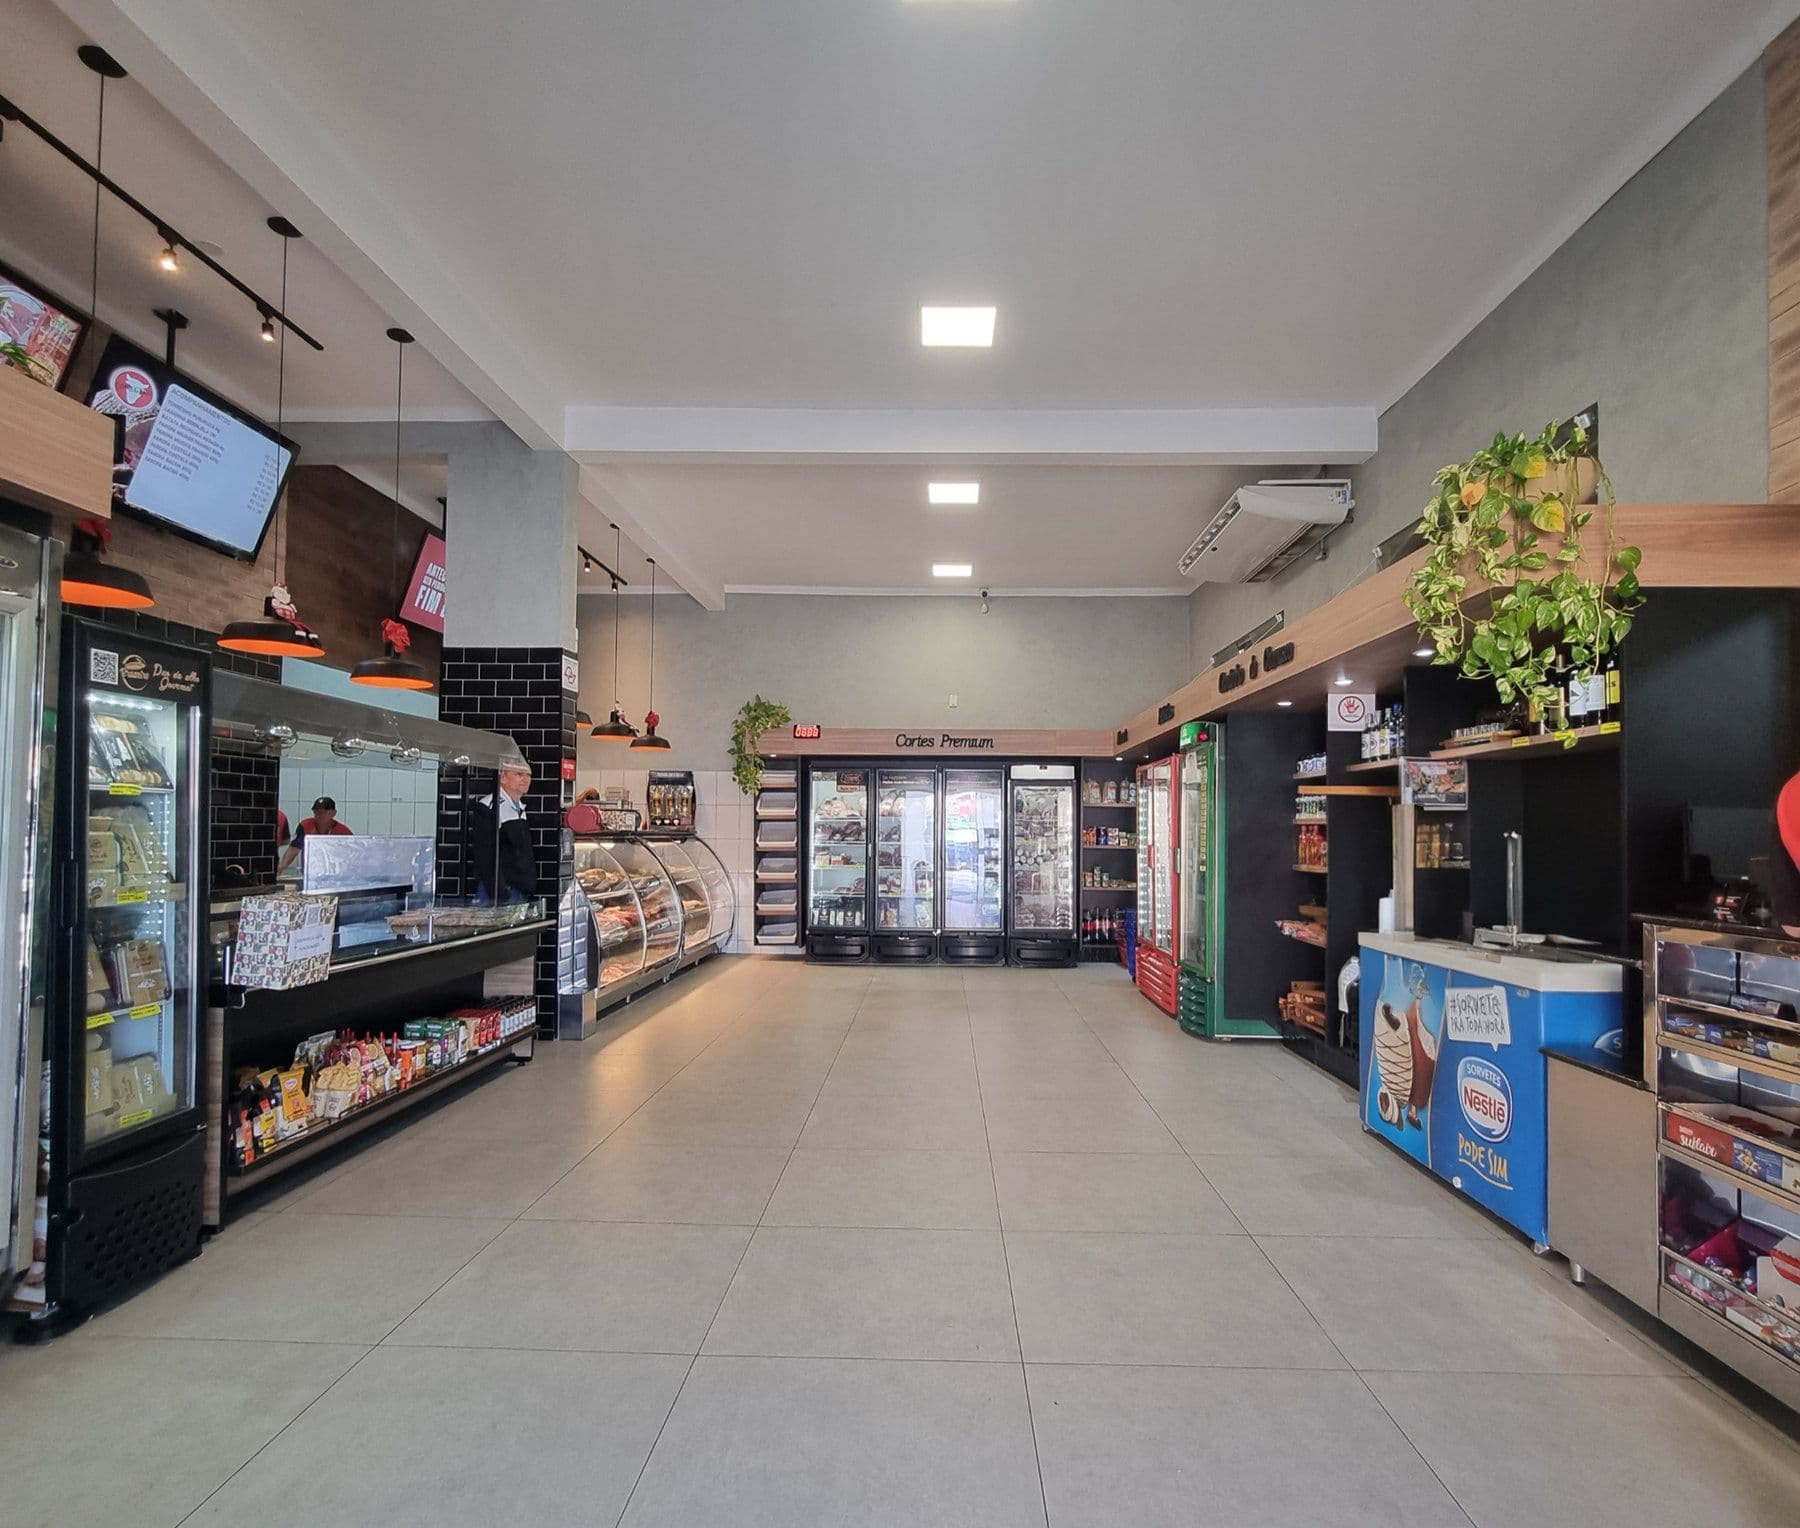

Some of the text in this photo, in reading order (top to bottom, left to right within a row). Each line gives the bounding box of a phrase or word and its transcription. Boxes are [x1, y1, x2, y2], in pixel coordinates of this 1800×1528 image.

[414, 584, 442, 615] FIM
[895, 734, 994, 748] Cortes Premium
[1466, 1063, 1502, 1087] SORVETES
[1458, 1132, 1509, 1183] PODE SIM
